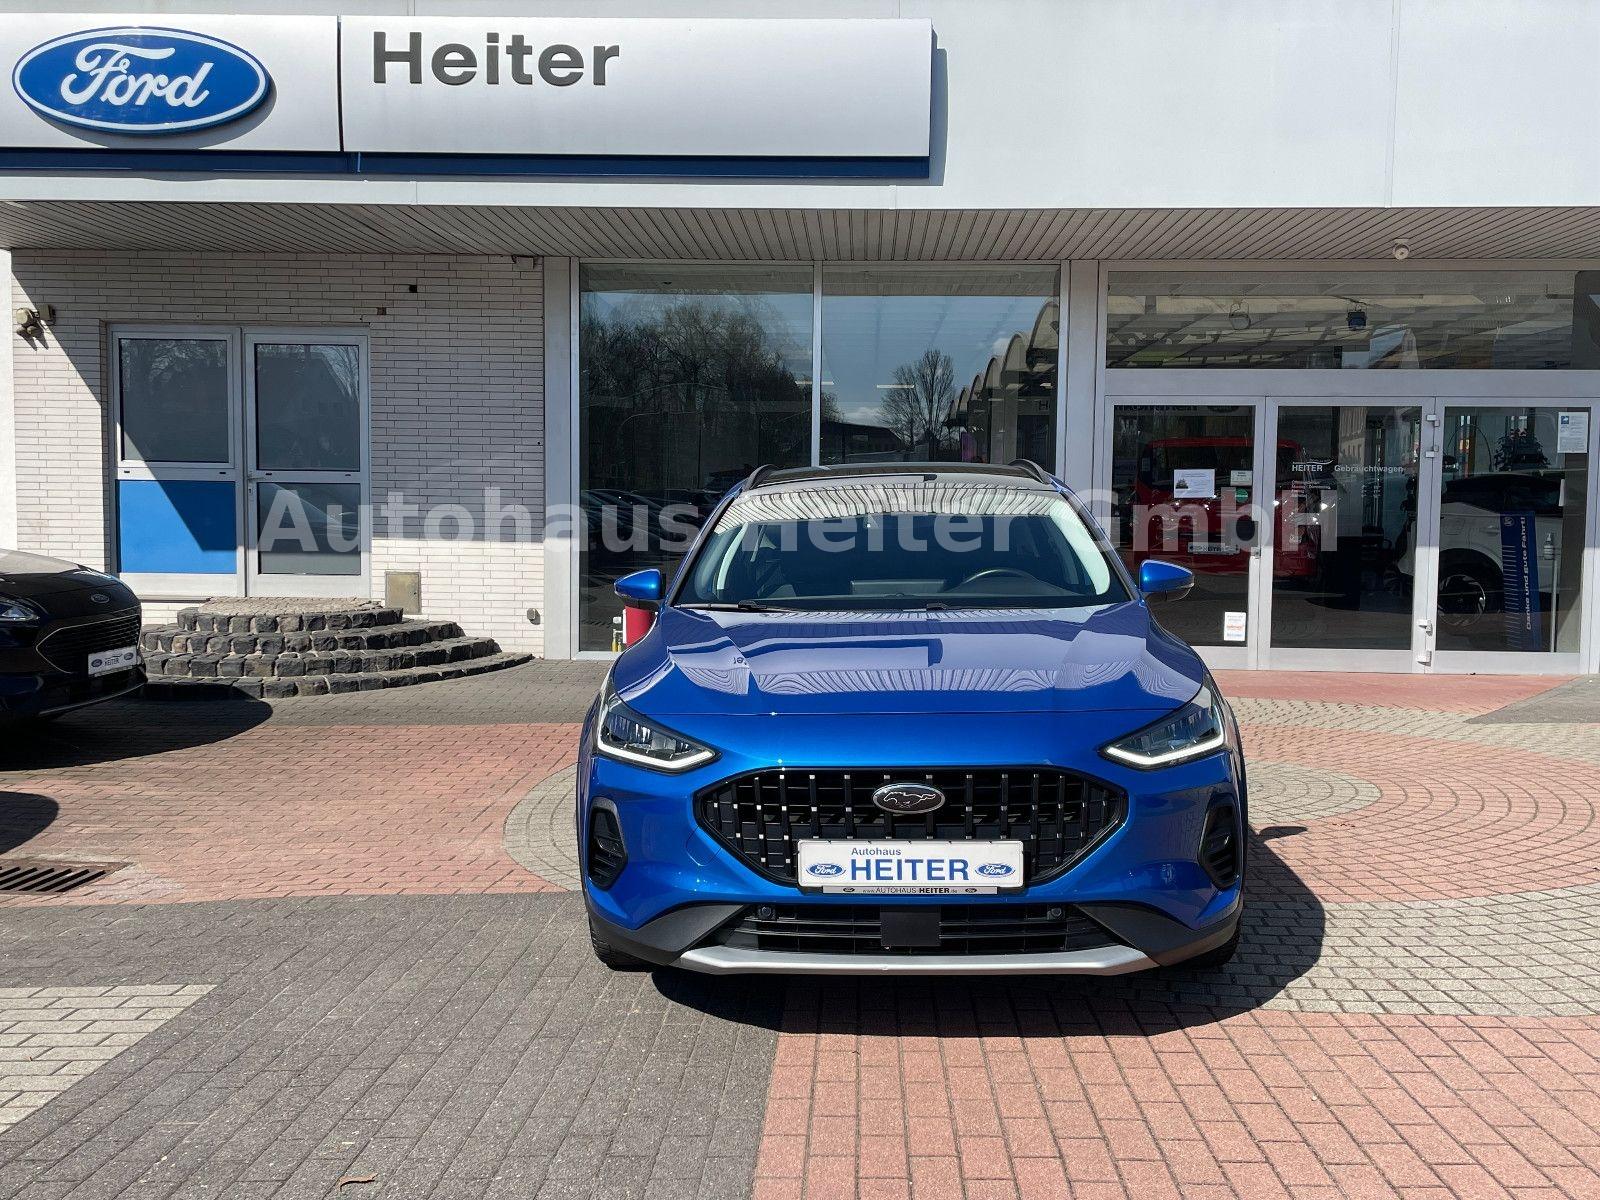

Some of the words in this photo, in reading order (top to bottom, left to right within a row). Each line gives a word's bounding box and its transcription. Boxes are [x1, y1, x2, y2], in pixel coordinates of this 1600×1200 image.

[373, 30, 621, 87] Heiter
[60, 42, 215, 108] Ford
[1291, 464, 1323, 472] HEITER
[1334, 465, 1404, 475] Gebrauchtwagen
[851, 847, 902, 856] Autohaus
[814, 864, 837, 875] Ford
[851, 858, 969, 880] HEITER
[983, 864, 1007, 875] Ford
